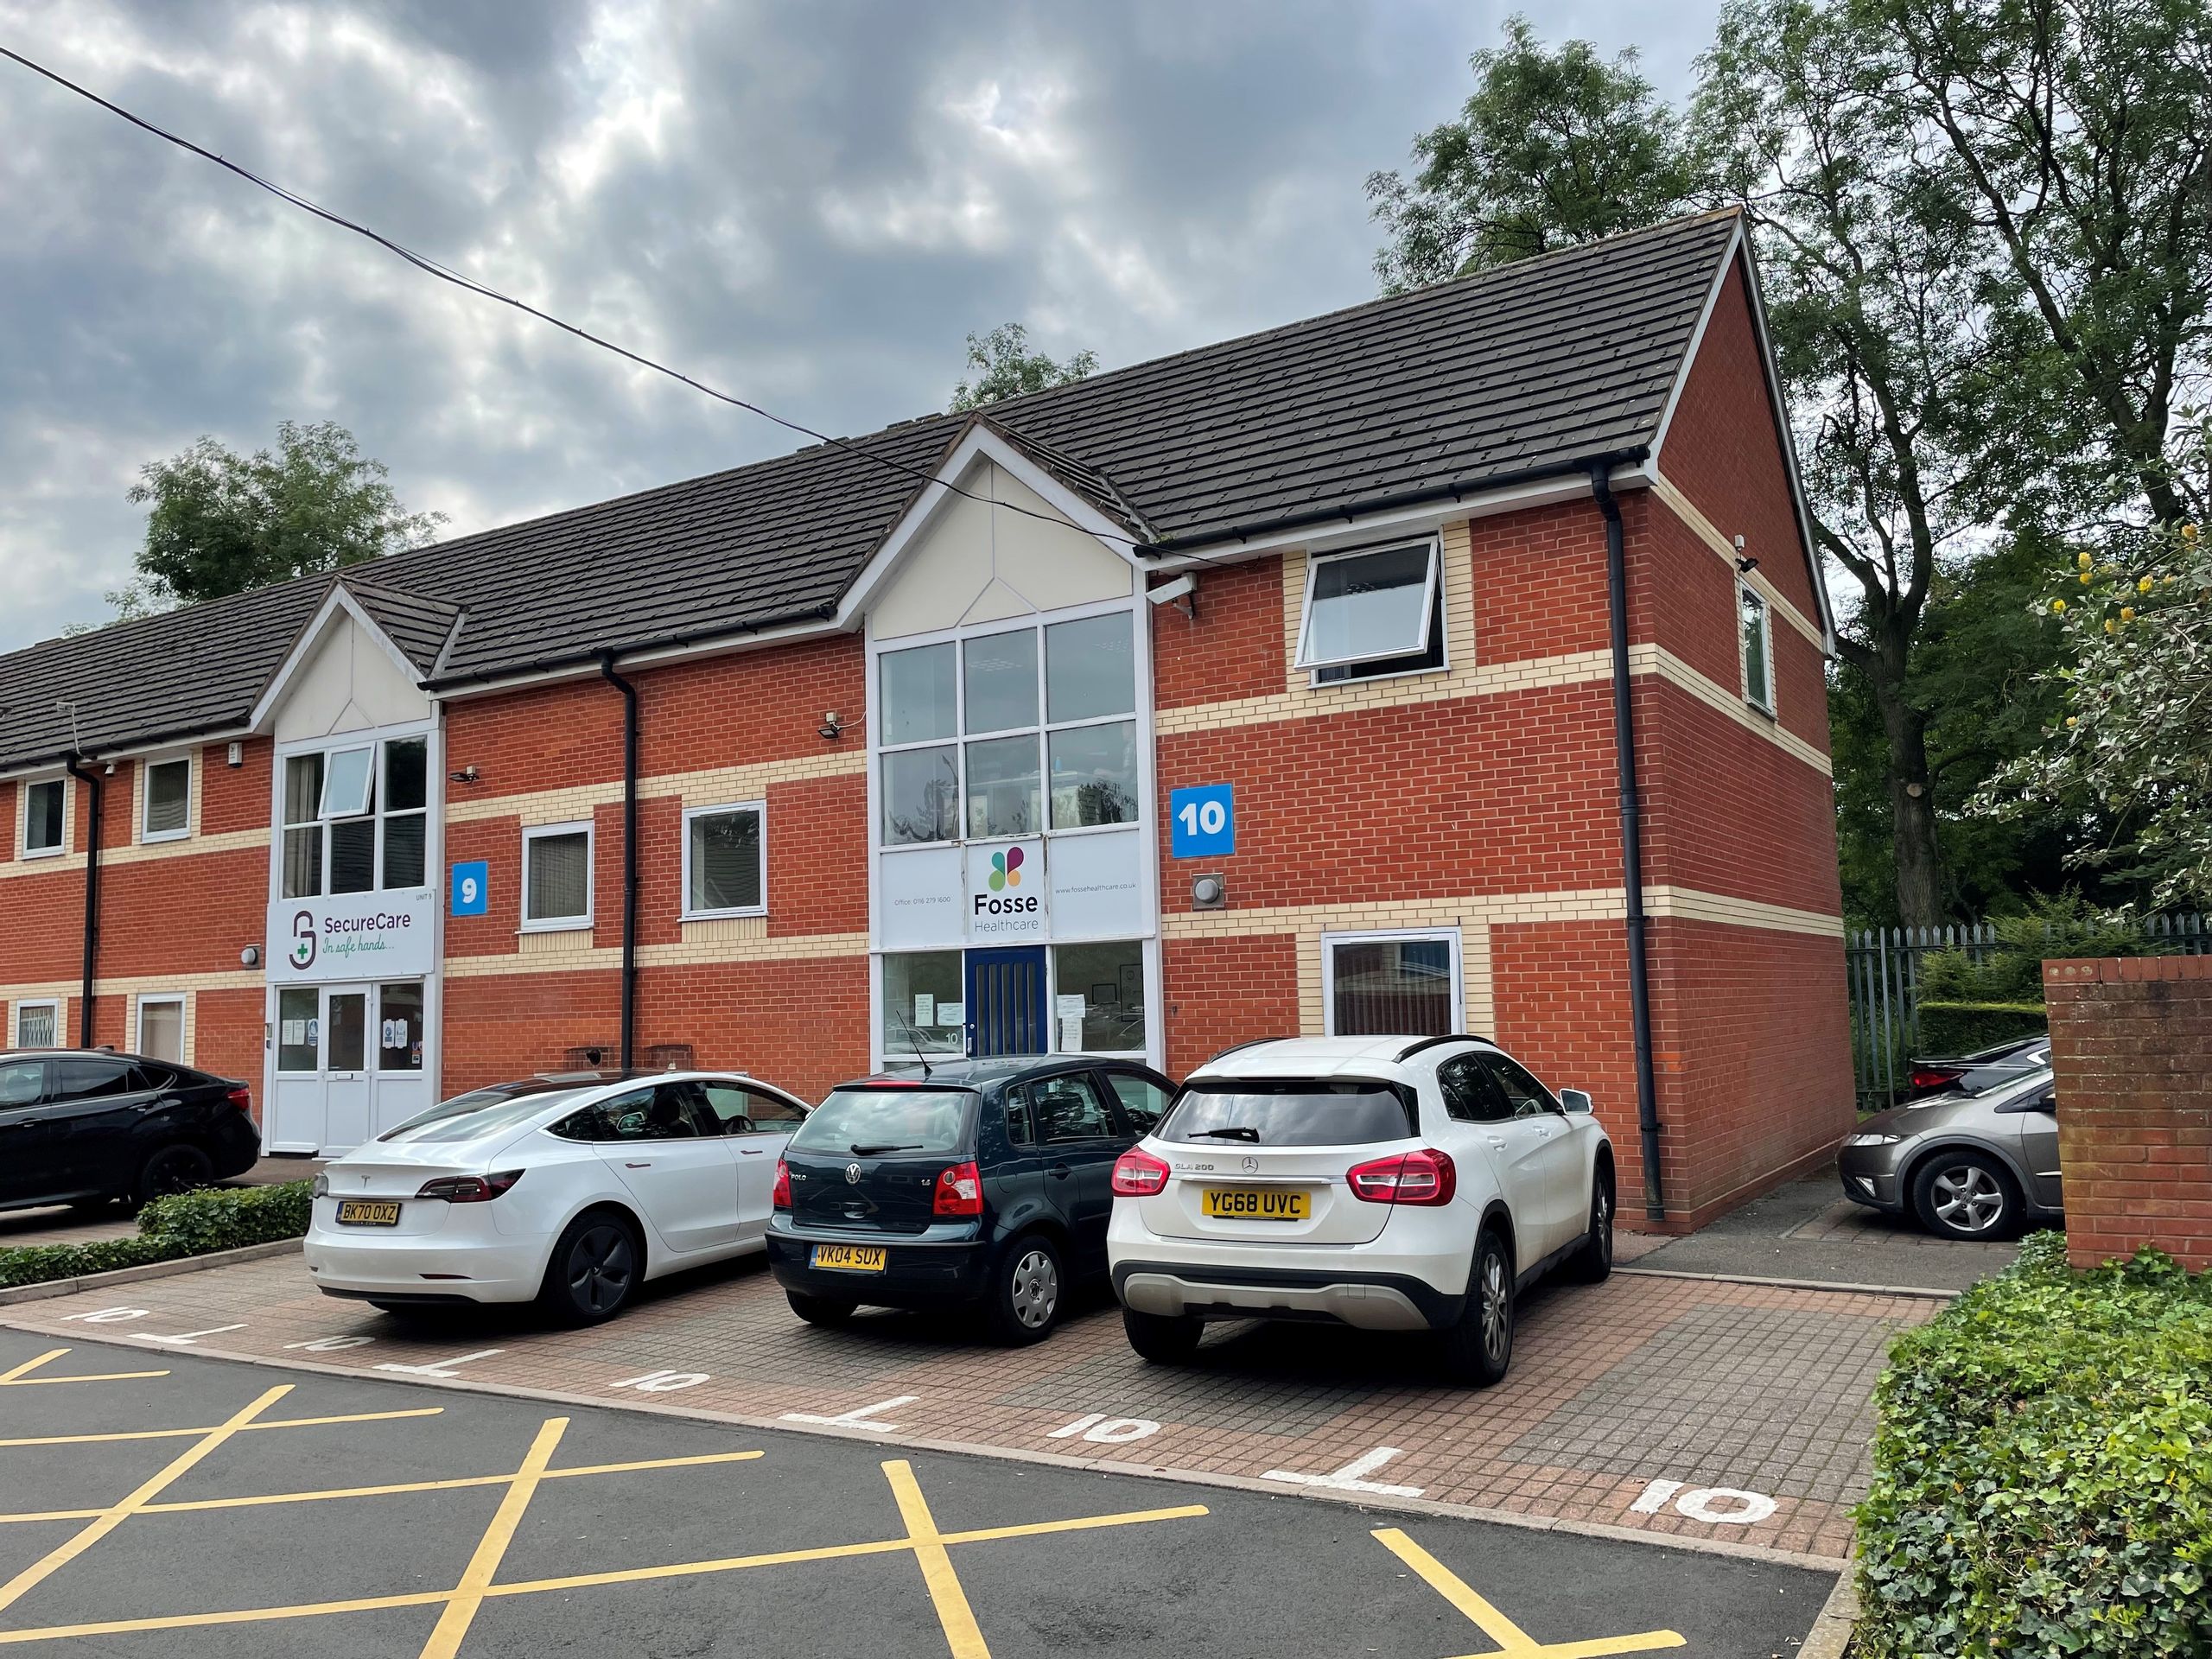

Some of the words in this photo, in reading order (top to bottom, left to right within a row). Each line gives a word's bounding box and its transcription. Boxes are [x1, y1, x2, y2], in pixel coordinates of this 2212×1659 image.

[1178, 800, 1226, 836] 10
[461, 877, 477, 904] 9
[1055, 882, 1136, 894] www.fossehealthcare.co.uk
[974, 893, 1038, 916] Fosse
[324, 912, 410, 934] SecureCare
[975, 919, 1039, 933] Healthcare
[322, 938, 333, 954] In
[335, 935, 356, 958] safe
[945, 1033, 958, 1045] 10
[343, 1204, 372, 1219] BK70
[373, 1205, 397, 1220] OXZ
[1210, 1192, 1258, 1212] YG68
[1263, 1193, 1301, 1214] UVC
[820, 1245, 851, 1264] VK04
[855, 1248, 882, 1266] SUX
[608, 1370, 711, 1392] 10
[1046, 1413, 1161, 1443] 10
[1630, 1478, 1781, 1524] 10
